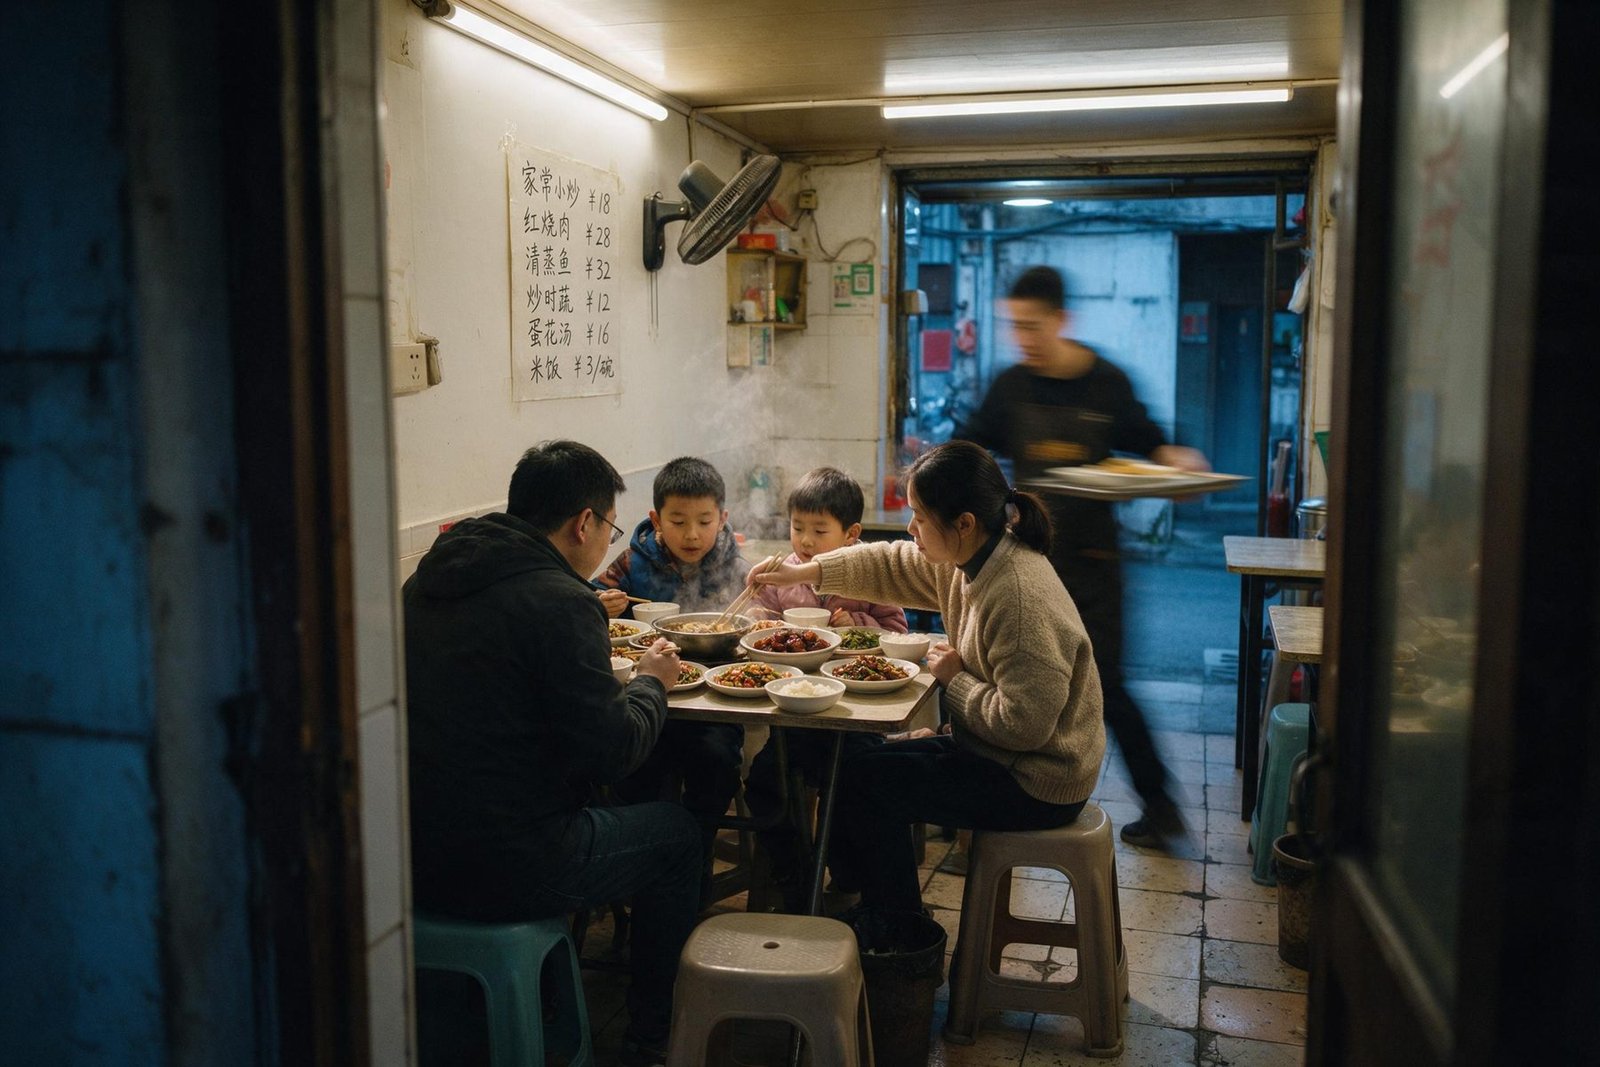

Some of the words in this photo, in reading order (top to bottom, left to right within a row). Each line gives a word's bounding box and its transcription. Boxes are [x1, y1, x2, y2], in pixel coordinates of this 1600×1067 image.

[522, 160, 580, 209] 家常小炒
[588, 188, 611, 215] ¥18
[523, 206, 570, 241] 红烧肉
[585, 222, 611, 248] ¥28
[525, 242, 571, 277] 清蒸鱼
[585, 256, 612, 281] ¥32
[526, 283, 574, 314] 炒时蔬
[585, 289, 611, 314] ¥12
[528, 317, 572, 347] 蛋花汤
[586, 321, 610, 346] ¥16
[530, 354, 563, 384] 米饭
